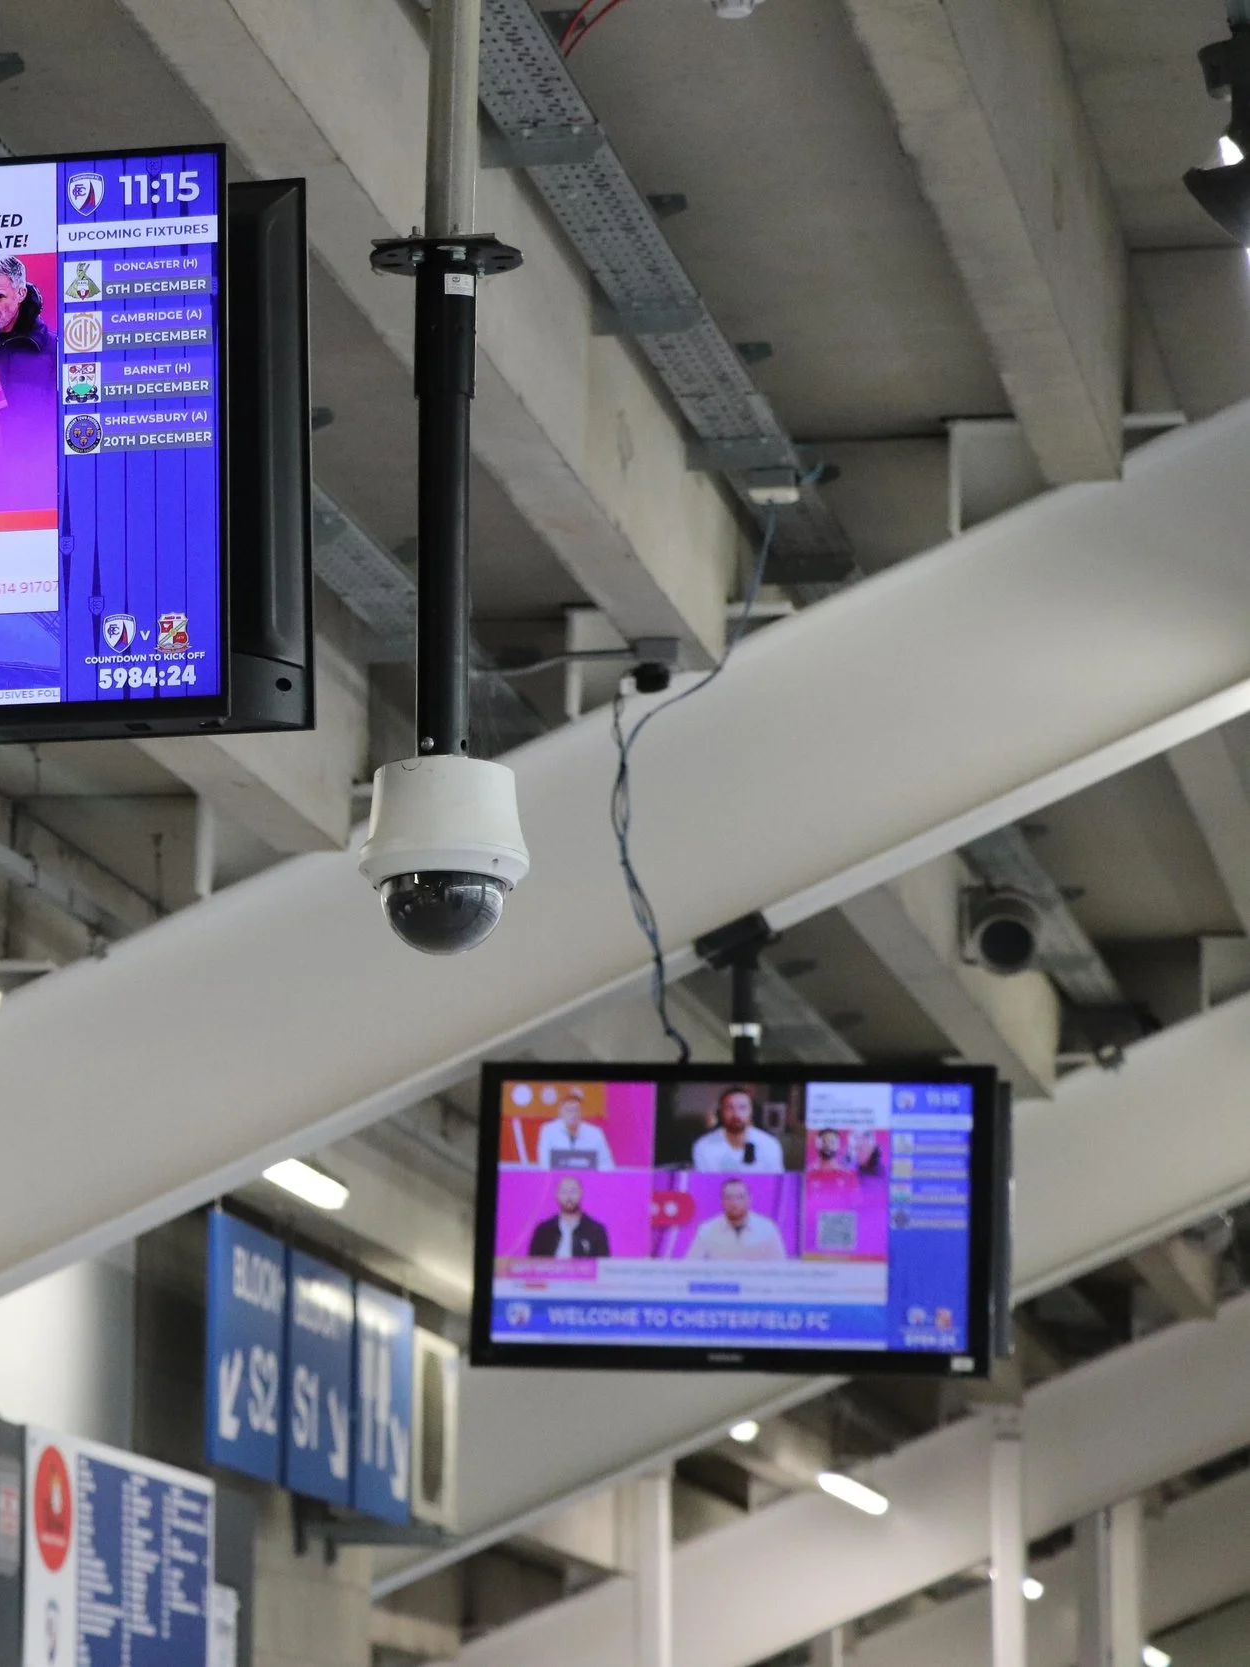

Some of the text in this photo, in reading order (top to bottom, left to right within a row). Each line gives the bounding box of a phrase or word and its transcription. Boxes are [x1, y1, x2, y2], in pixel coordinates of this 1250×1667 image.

[118, 170, 200, 206] 11:15
[68, 223, 209, 242] UPCOMING FIXTURES
[113, 258, 198, 272] DONCASTER (H)
[105, 279, 207, 295] 6TH DECEMBER
[111, 309, 202, 323] CAMBRIDGE (A)
[106, 329, 207, 345] 9TH DECEMBER
[123, 362, 191, 376] BARNET (H)
[104, 380, 209, 396] 13TH DECEMBER
[104, 411, 207, 426] SHREWSBURY (A)
[104, 431, 212, 447] 20TH DECEMBER
[84, 651, 206, 664] COUNTDOWN TO KICK OFF
[98, 664, 197, 690] 5984:24
[37, 689, 59, 698] FOL
[548, 1305, 831, 1332] WELCOME TO CHESTERFIELD FC
